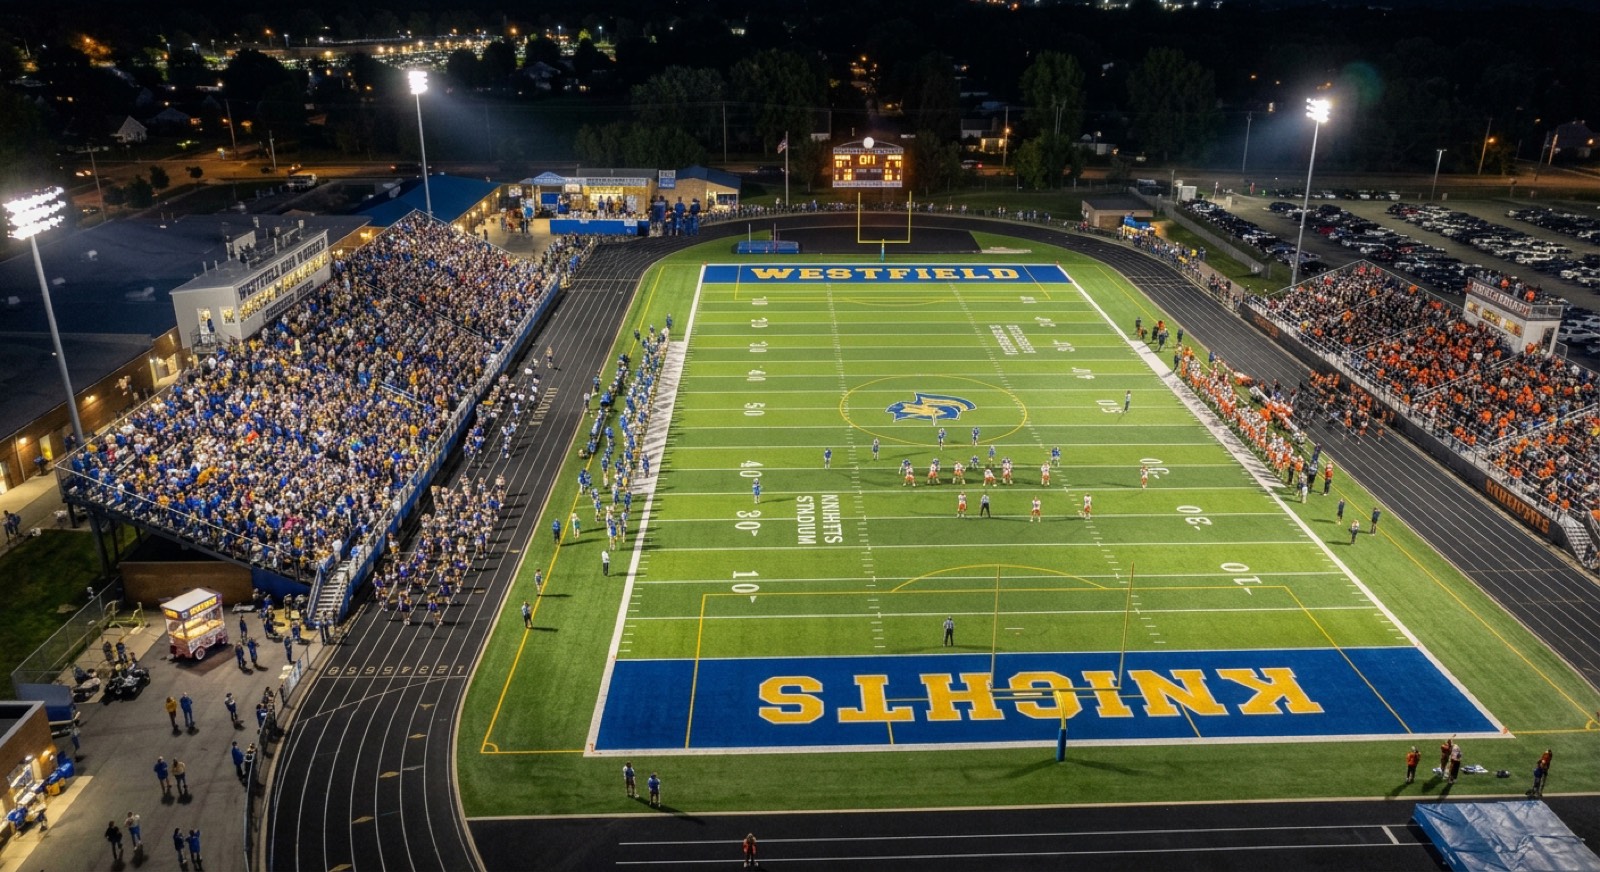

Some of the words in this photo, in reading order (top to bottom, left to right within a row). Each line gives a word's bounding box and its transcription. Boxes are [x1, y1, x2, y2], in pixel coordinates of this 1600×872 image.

[751, 267, 1020, 280] WESTFIELD
[735, 510, 762, 530] 30
[1176, 505, 1213, 526] 30
[732, 570, 760, 593] 10
[1220, 562, 1262, 585] 10
[758, 666, 1325, 725] KNIGHTS
